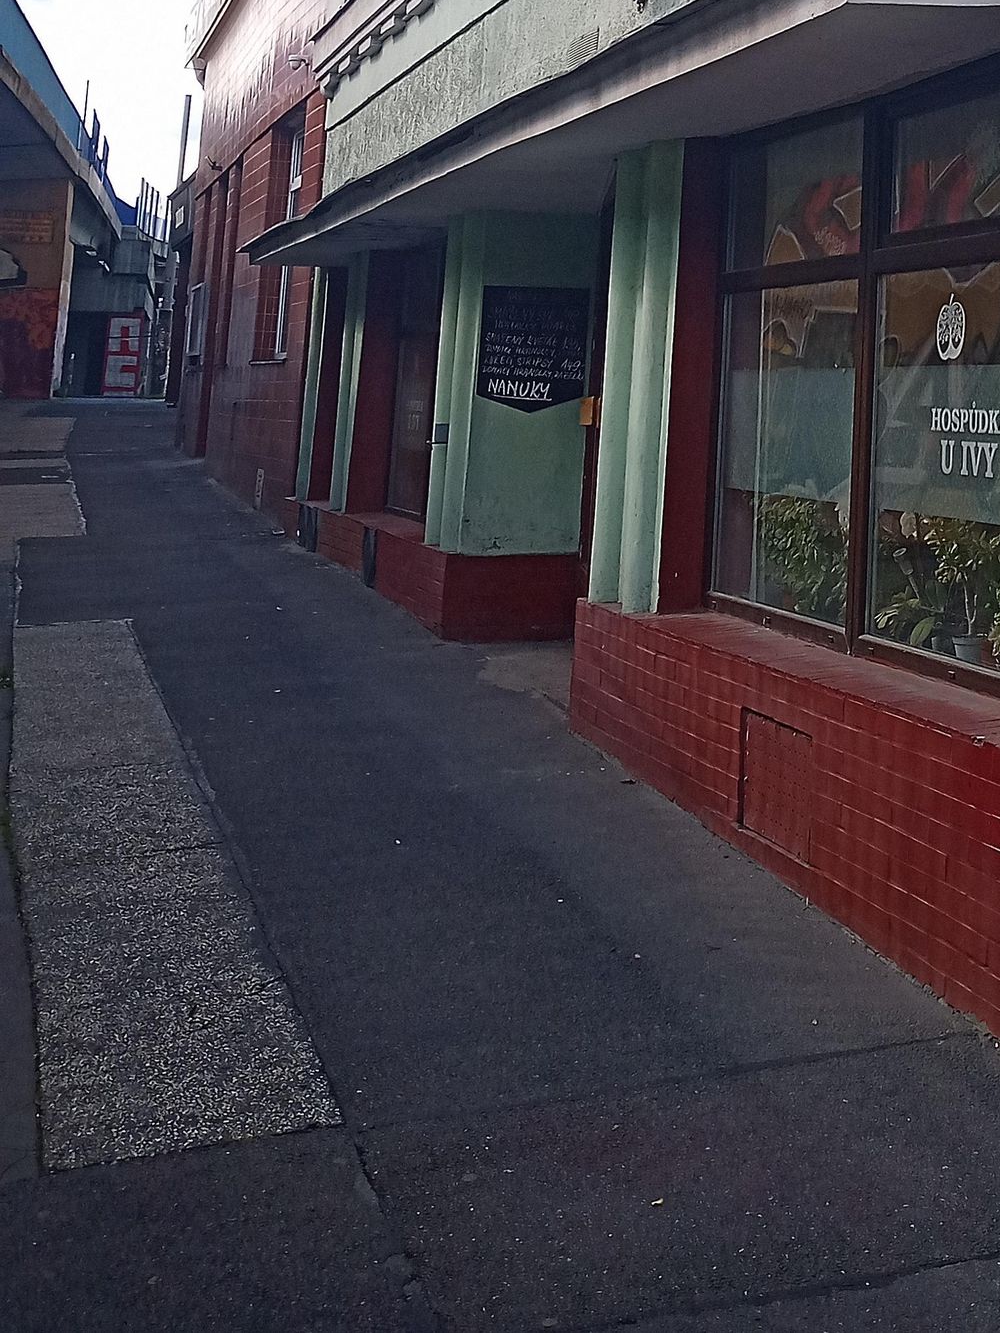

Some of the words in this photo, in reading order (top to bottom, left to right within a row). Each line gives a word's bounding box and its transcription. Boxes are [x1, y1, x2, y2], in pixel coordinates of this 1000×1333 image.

[488, 379, 550, 400] NANUKY
[941, 440, 955, 475] U
[960, 441, 998, 478] IVY
